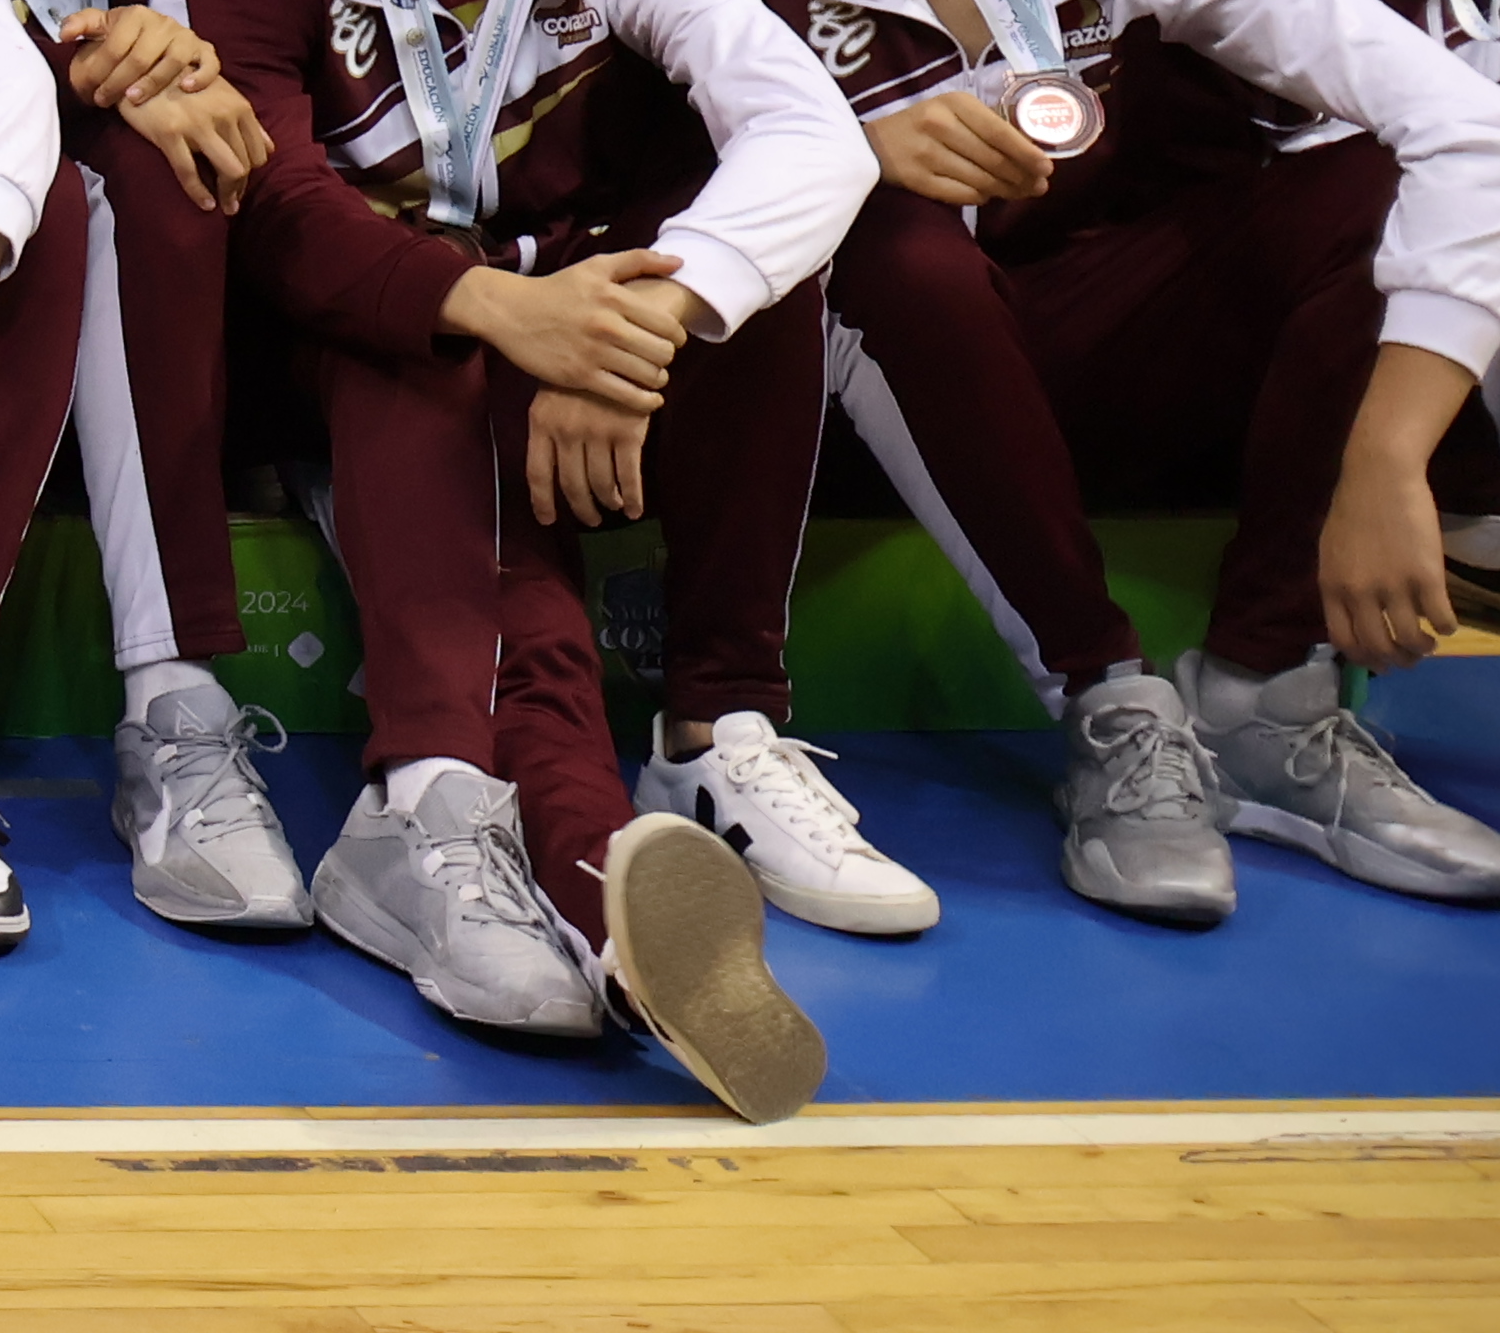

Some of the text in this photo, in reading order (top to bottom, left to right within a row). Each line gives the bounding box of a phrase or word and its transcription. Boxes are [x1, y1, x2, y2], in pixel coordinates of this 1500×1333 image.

[485, 15, 508, 71] CONADE
[417, 49, 447, 125] EDUCACIÓN
[240, 589, 309, 615] 2024
